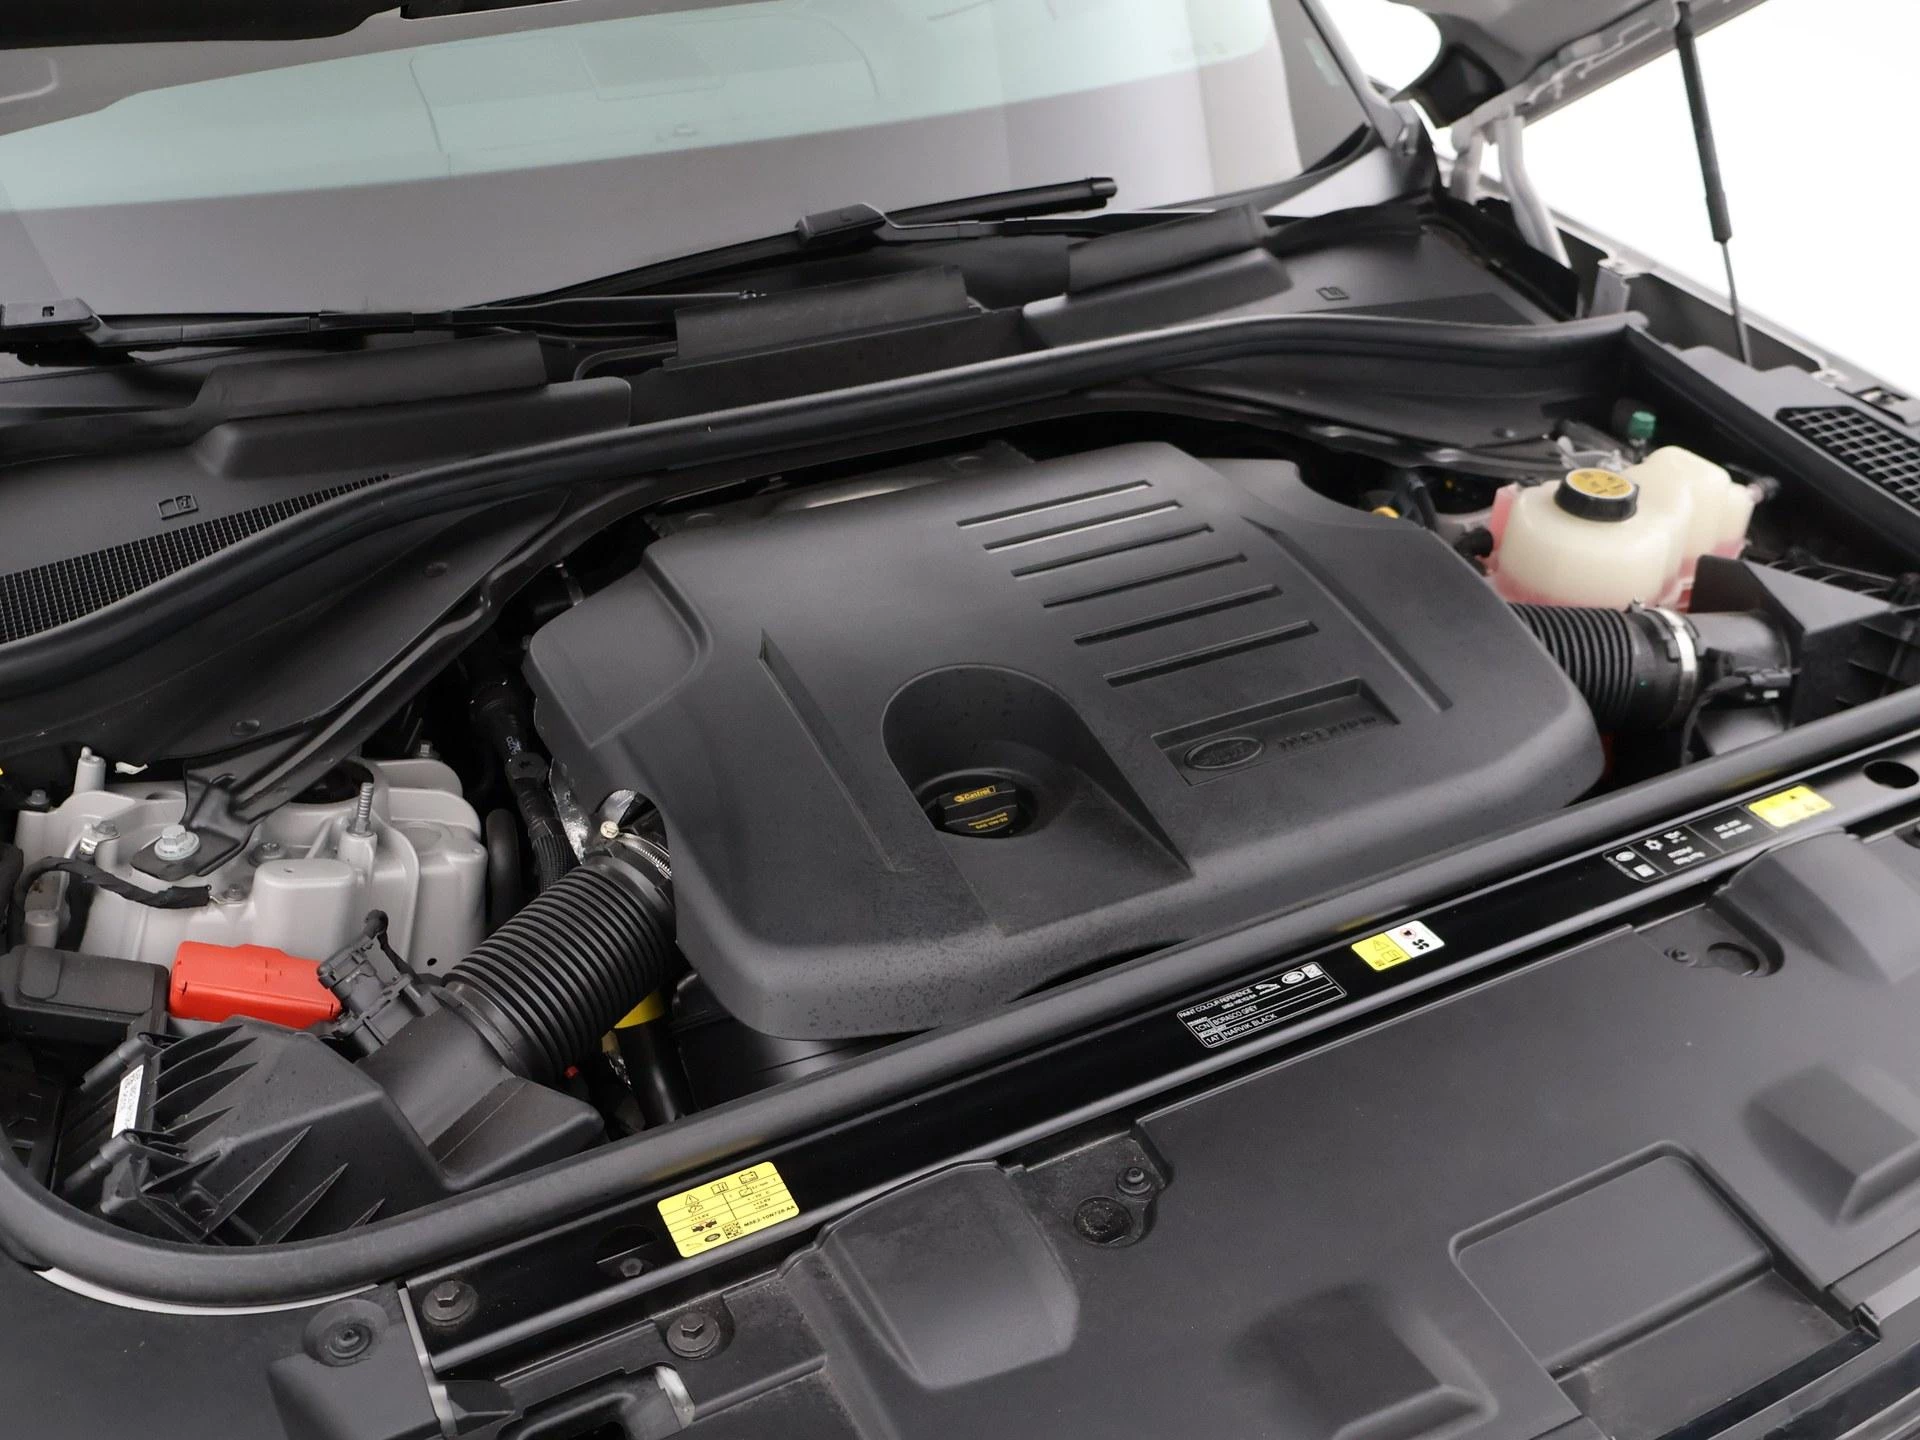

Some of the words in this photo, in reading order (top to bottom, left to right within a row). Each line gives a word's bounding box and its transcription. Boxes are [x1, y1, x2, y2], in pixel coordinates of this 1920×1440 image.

[1179, 1008, 1196, 1018] PAINT
[1197, 1000, 1219, 1013] COLOUR
[1219, 988, 1253, 1004] REFERENCE
[1241, 1004, 1258, 1018] GREY
[1223, 1023, 1252, 1038] NARVIK
[1252, 1013, 1277, 1028] BLACK
